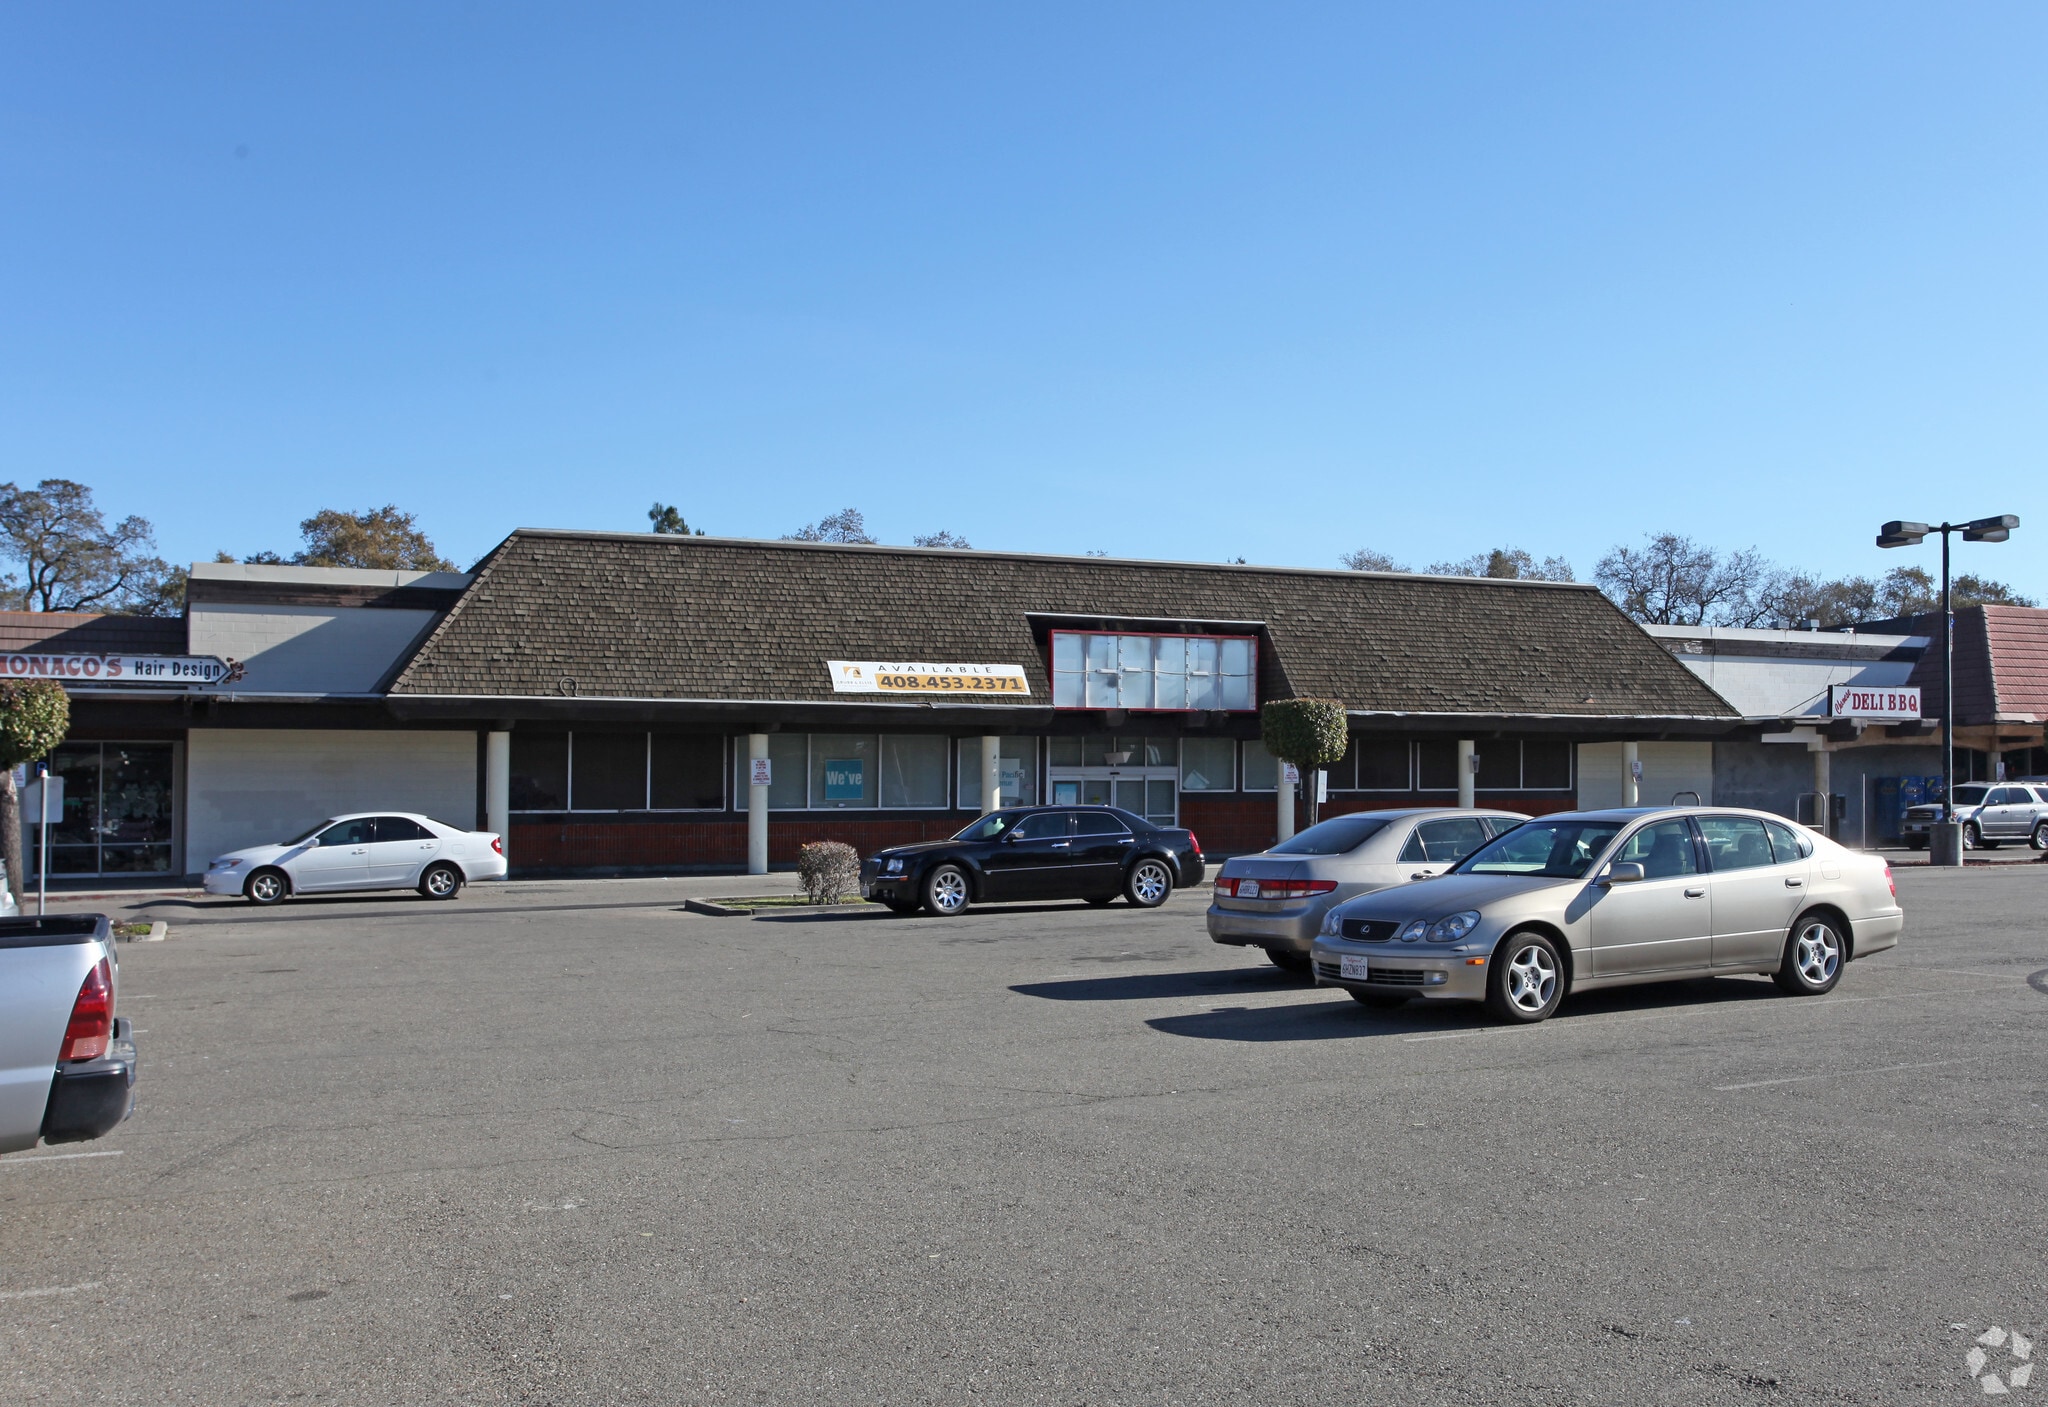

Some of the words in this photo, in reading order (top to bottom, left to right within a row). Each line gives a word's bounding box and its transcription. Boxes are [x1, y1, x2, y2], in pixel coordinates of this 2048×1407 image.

[135, 660, 165, 677] Hair
[172, 662, 221, 680] Design
[878, 664, 992, 674] AVAILABLE
[881, 675, 1022, 690] 408.453.2371
[1852, 693, 1884, 710] DELI
[1888, 694, 1918, 712] BBQ
[826, 771, 862, 785] We've
